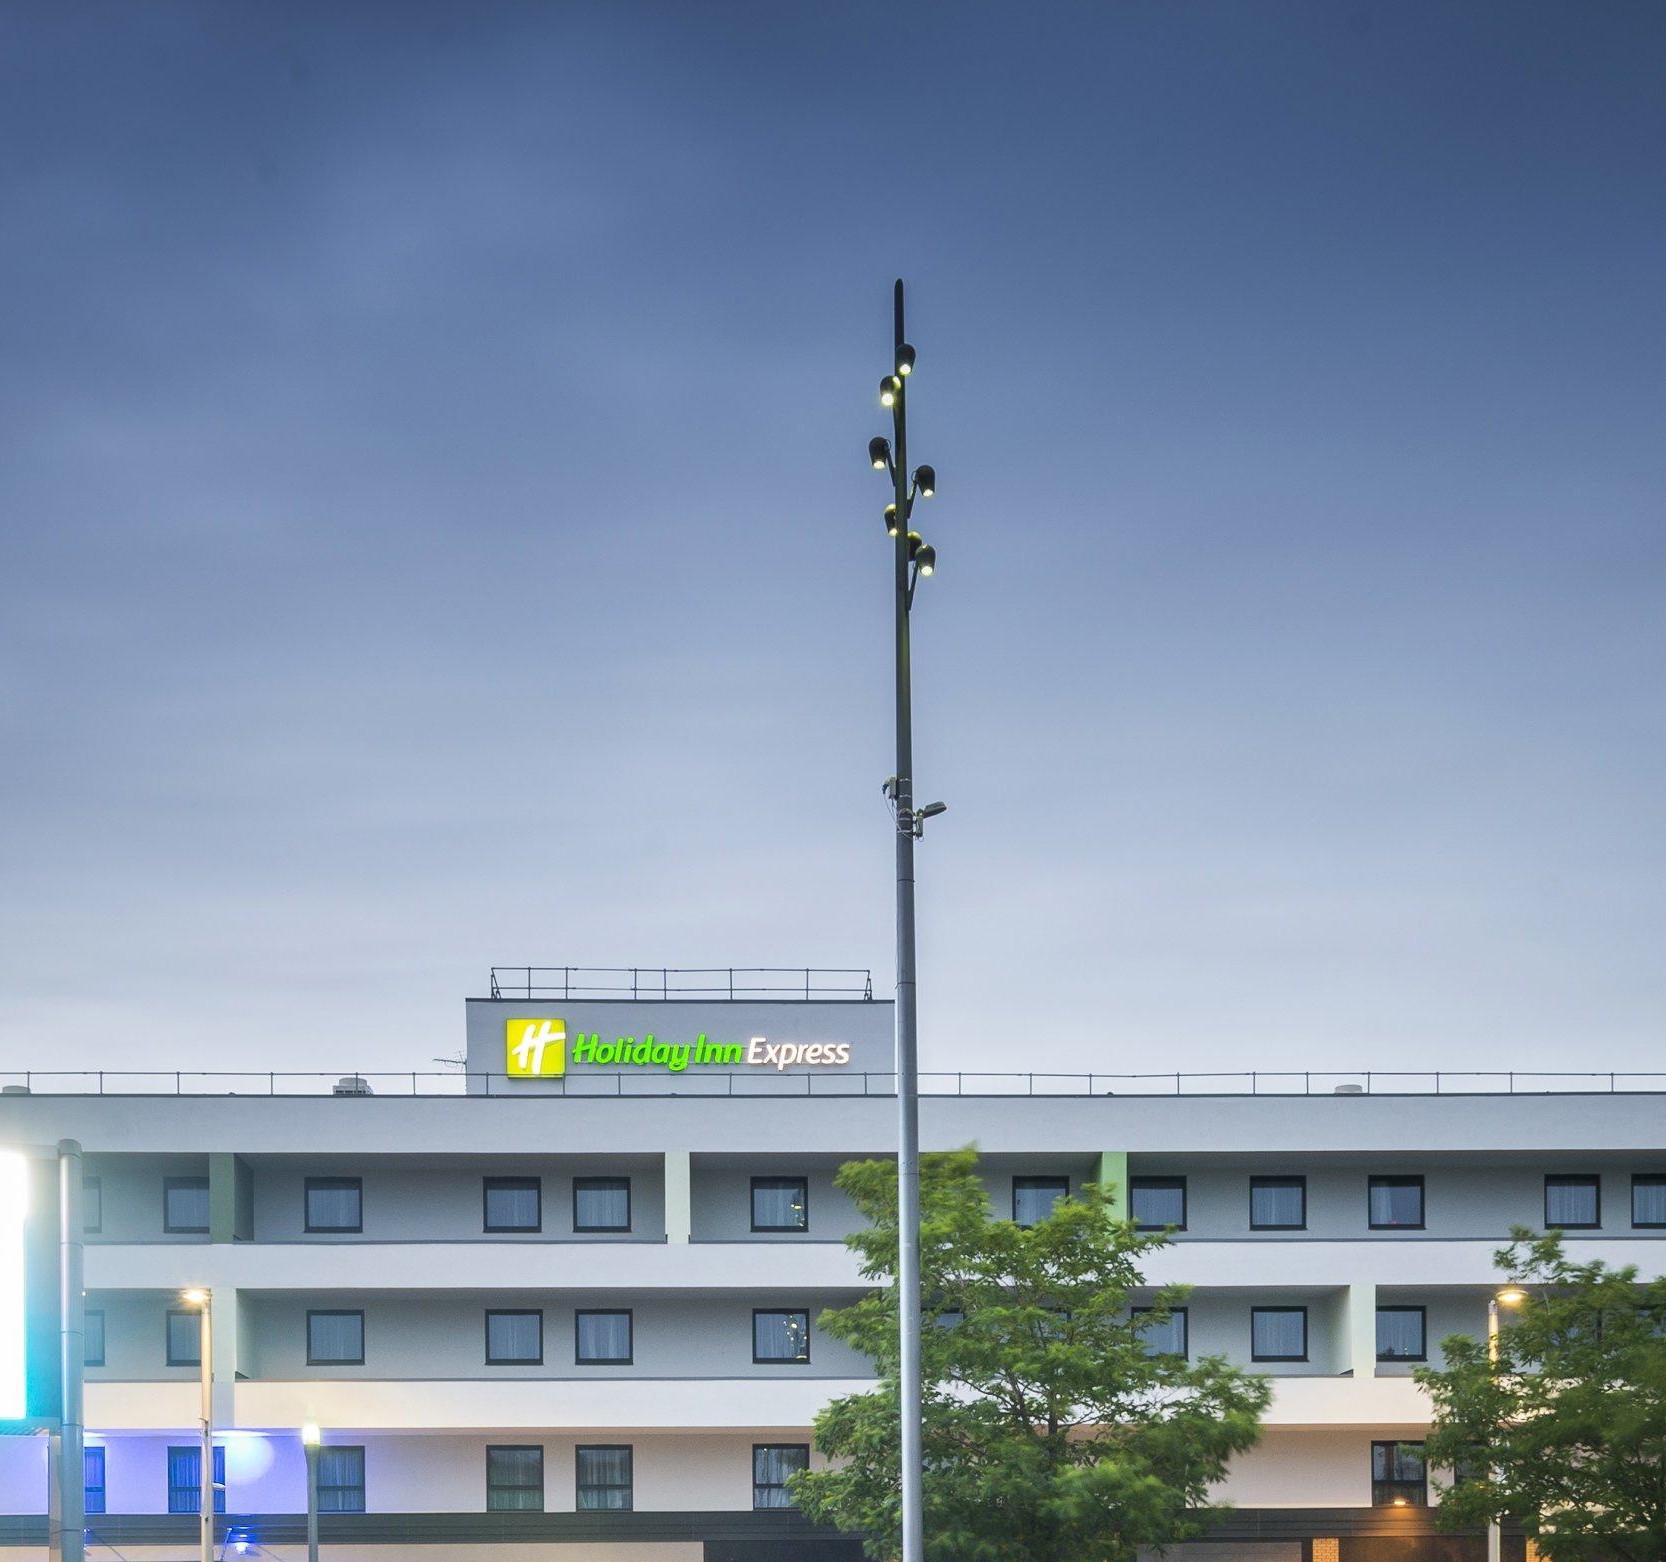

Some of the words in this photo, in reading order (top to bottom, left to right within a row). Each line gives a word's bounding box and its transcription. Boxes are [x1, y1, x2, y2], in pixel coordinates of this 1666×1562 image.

[573, 1032, 691, 1071] Holiday
[694, 1032, 743, 1064] Inn
[747, 1036, 851, 1071] Express
